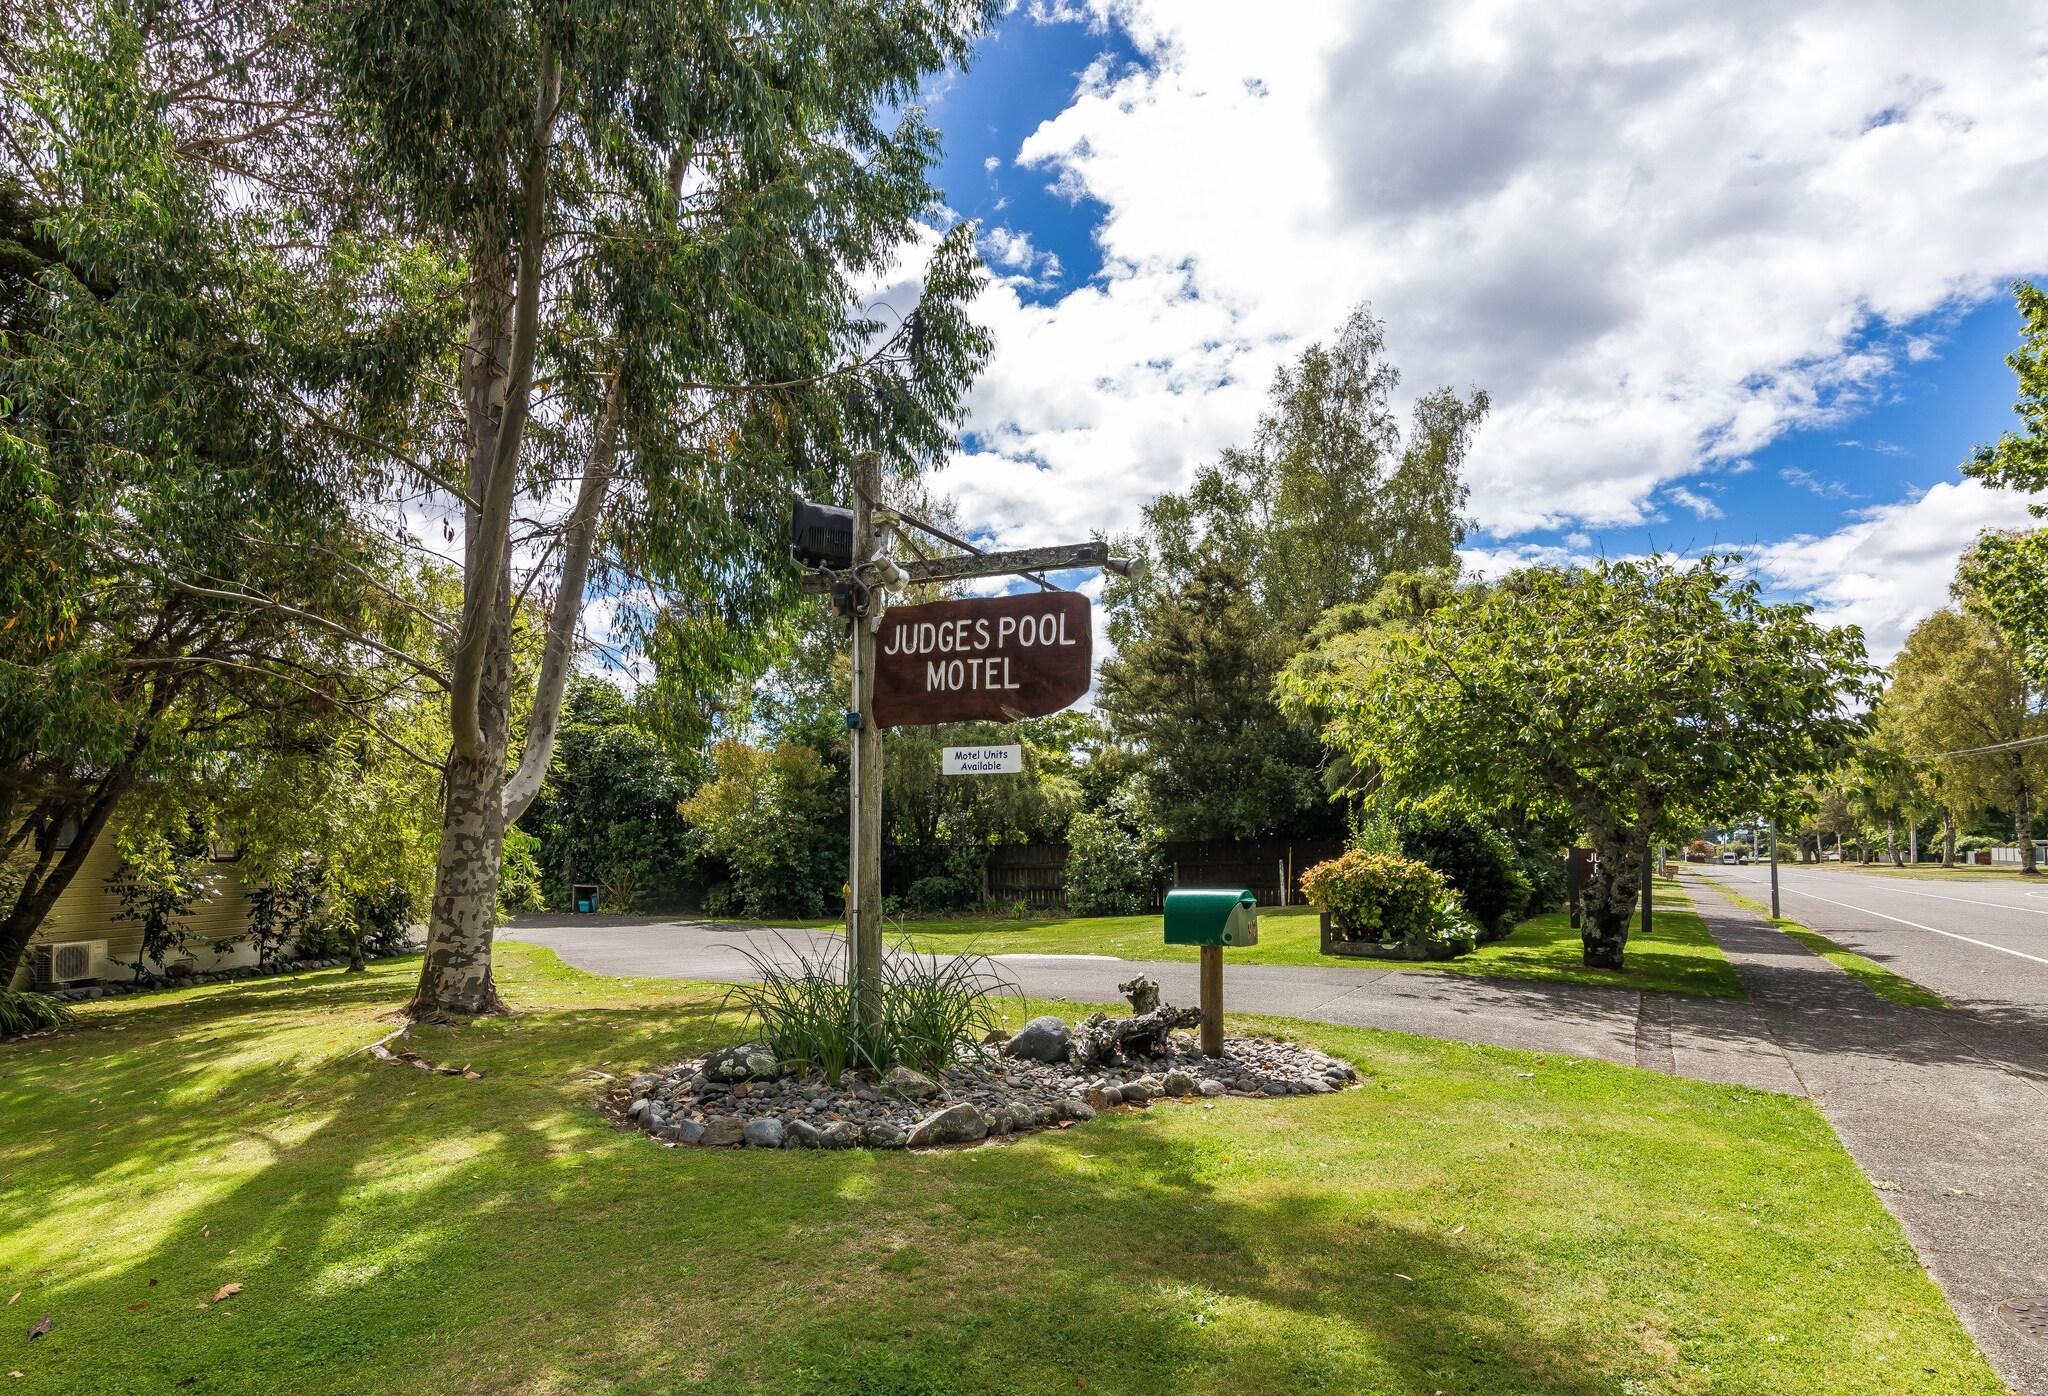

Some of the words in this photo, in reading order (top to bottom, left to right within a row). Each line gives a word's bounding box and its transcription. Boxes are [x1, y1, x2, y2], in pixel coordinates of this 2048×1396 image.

[884, 618, 990, 655] JUDGES
[998, 612, 1076, 648] POOL
[926, 656, 1020, 692] MOTEL
[954, 750, 980, 760] Motel
[984, 749, 1008, 760] Units
[961, 761, 1001, 771] Available
